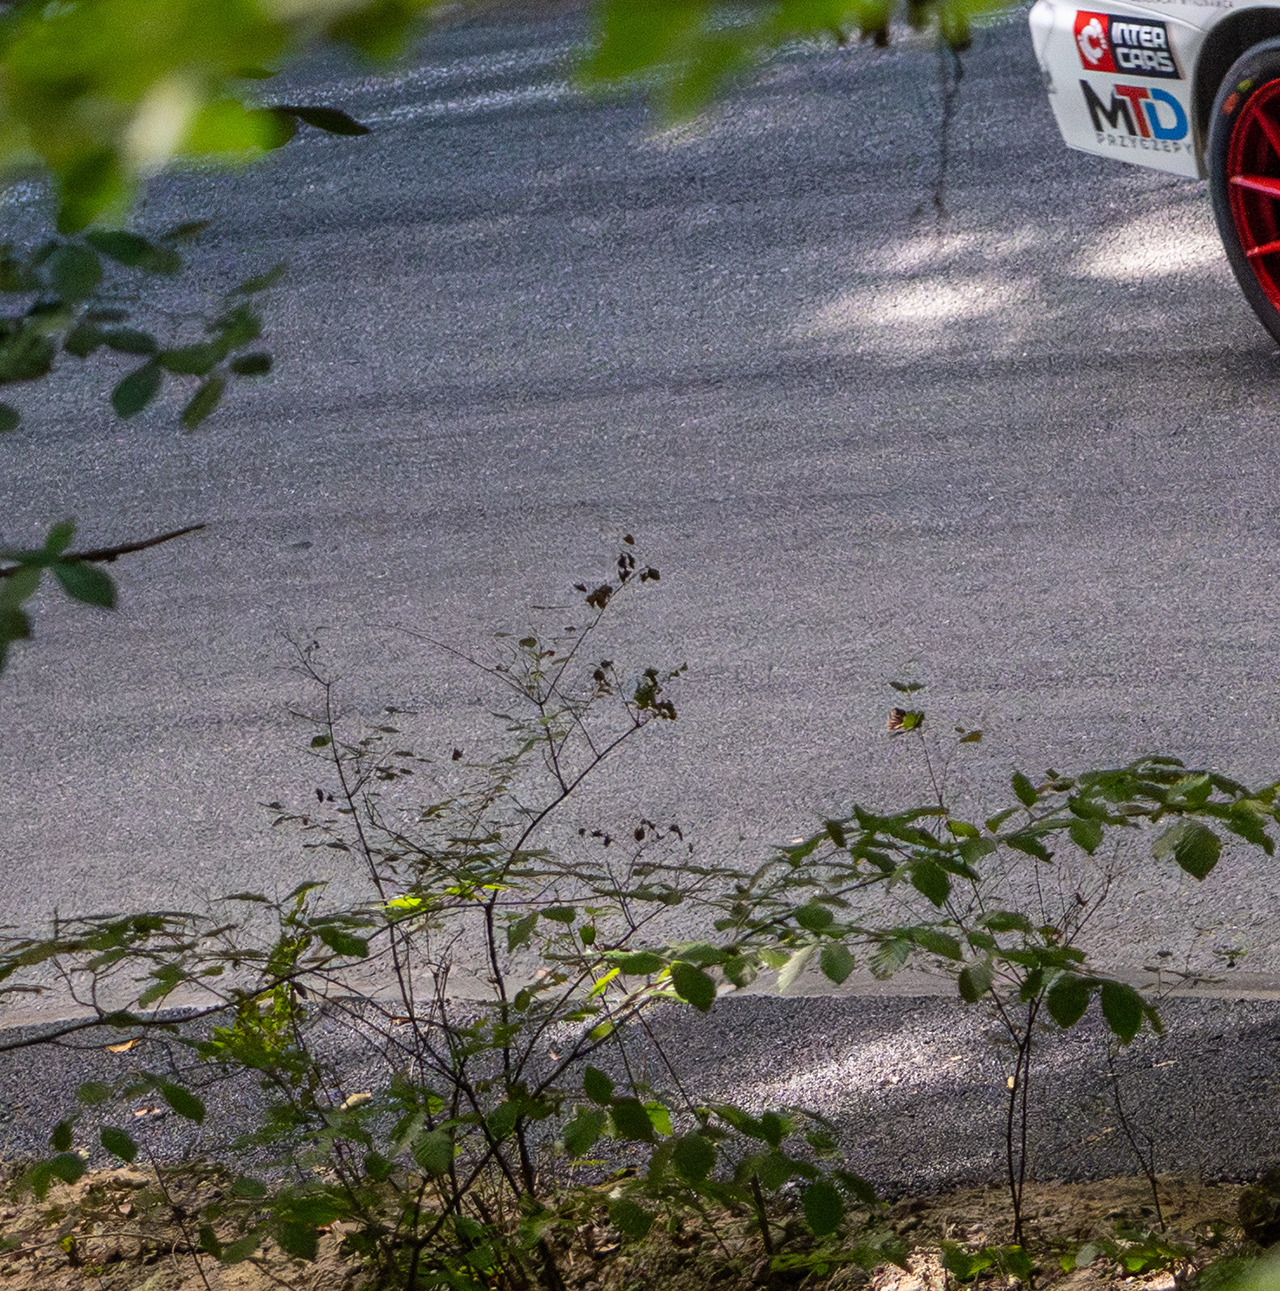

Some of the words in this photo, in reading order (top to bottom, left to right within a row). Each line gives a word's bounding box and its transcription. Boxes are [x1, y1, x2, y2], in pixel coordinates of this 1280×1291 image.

[1111, 22, 1167, 48] INTER
[1115, 47, 1175, 72] CARS
[1079, 79, 1188, 140] MTD
